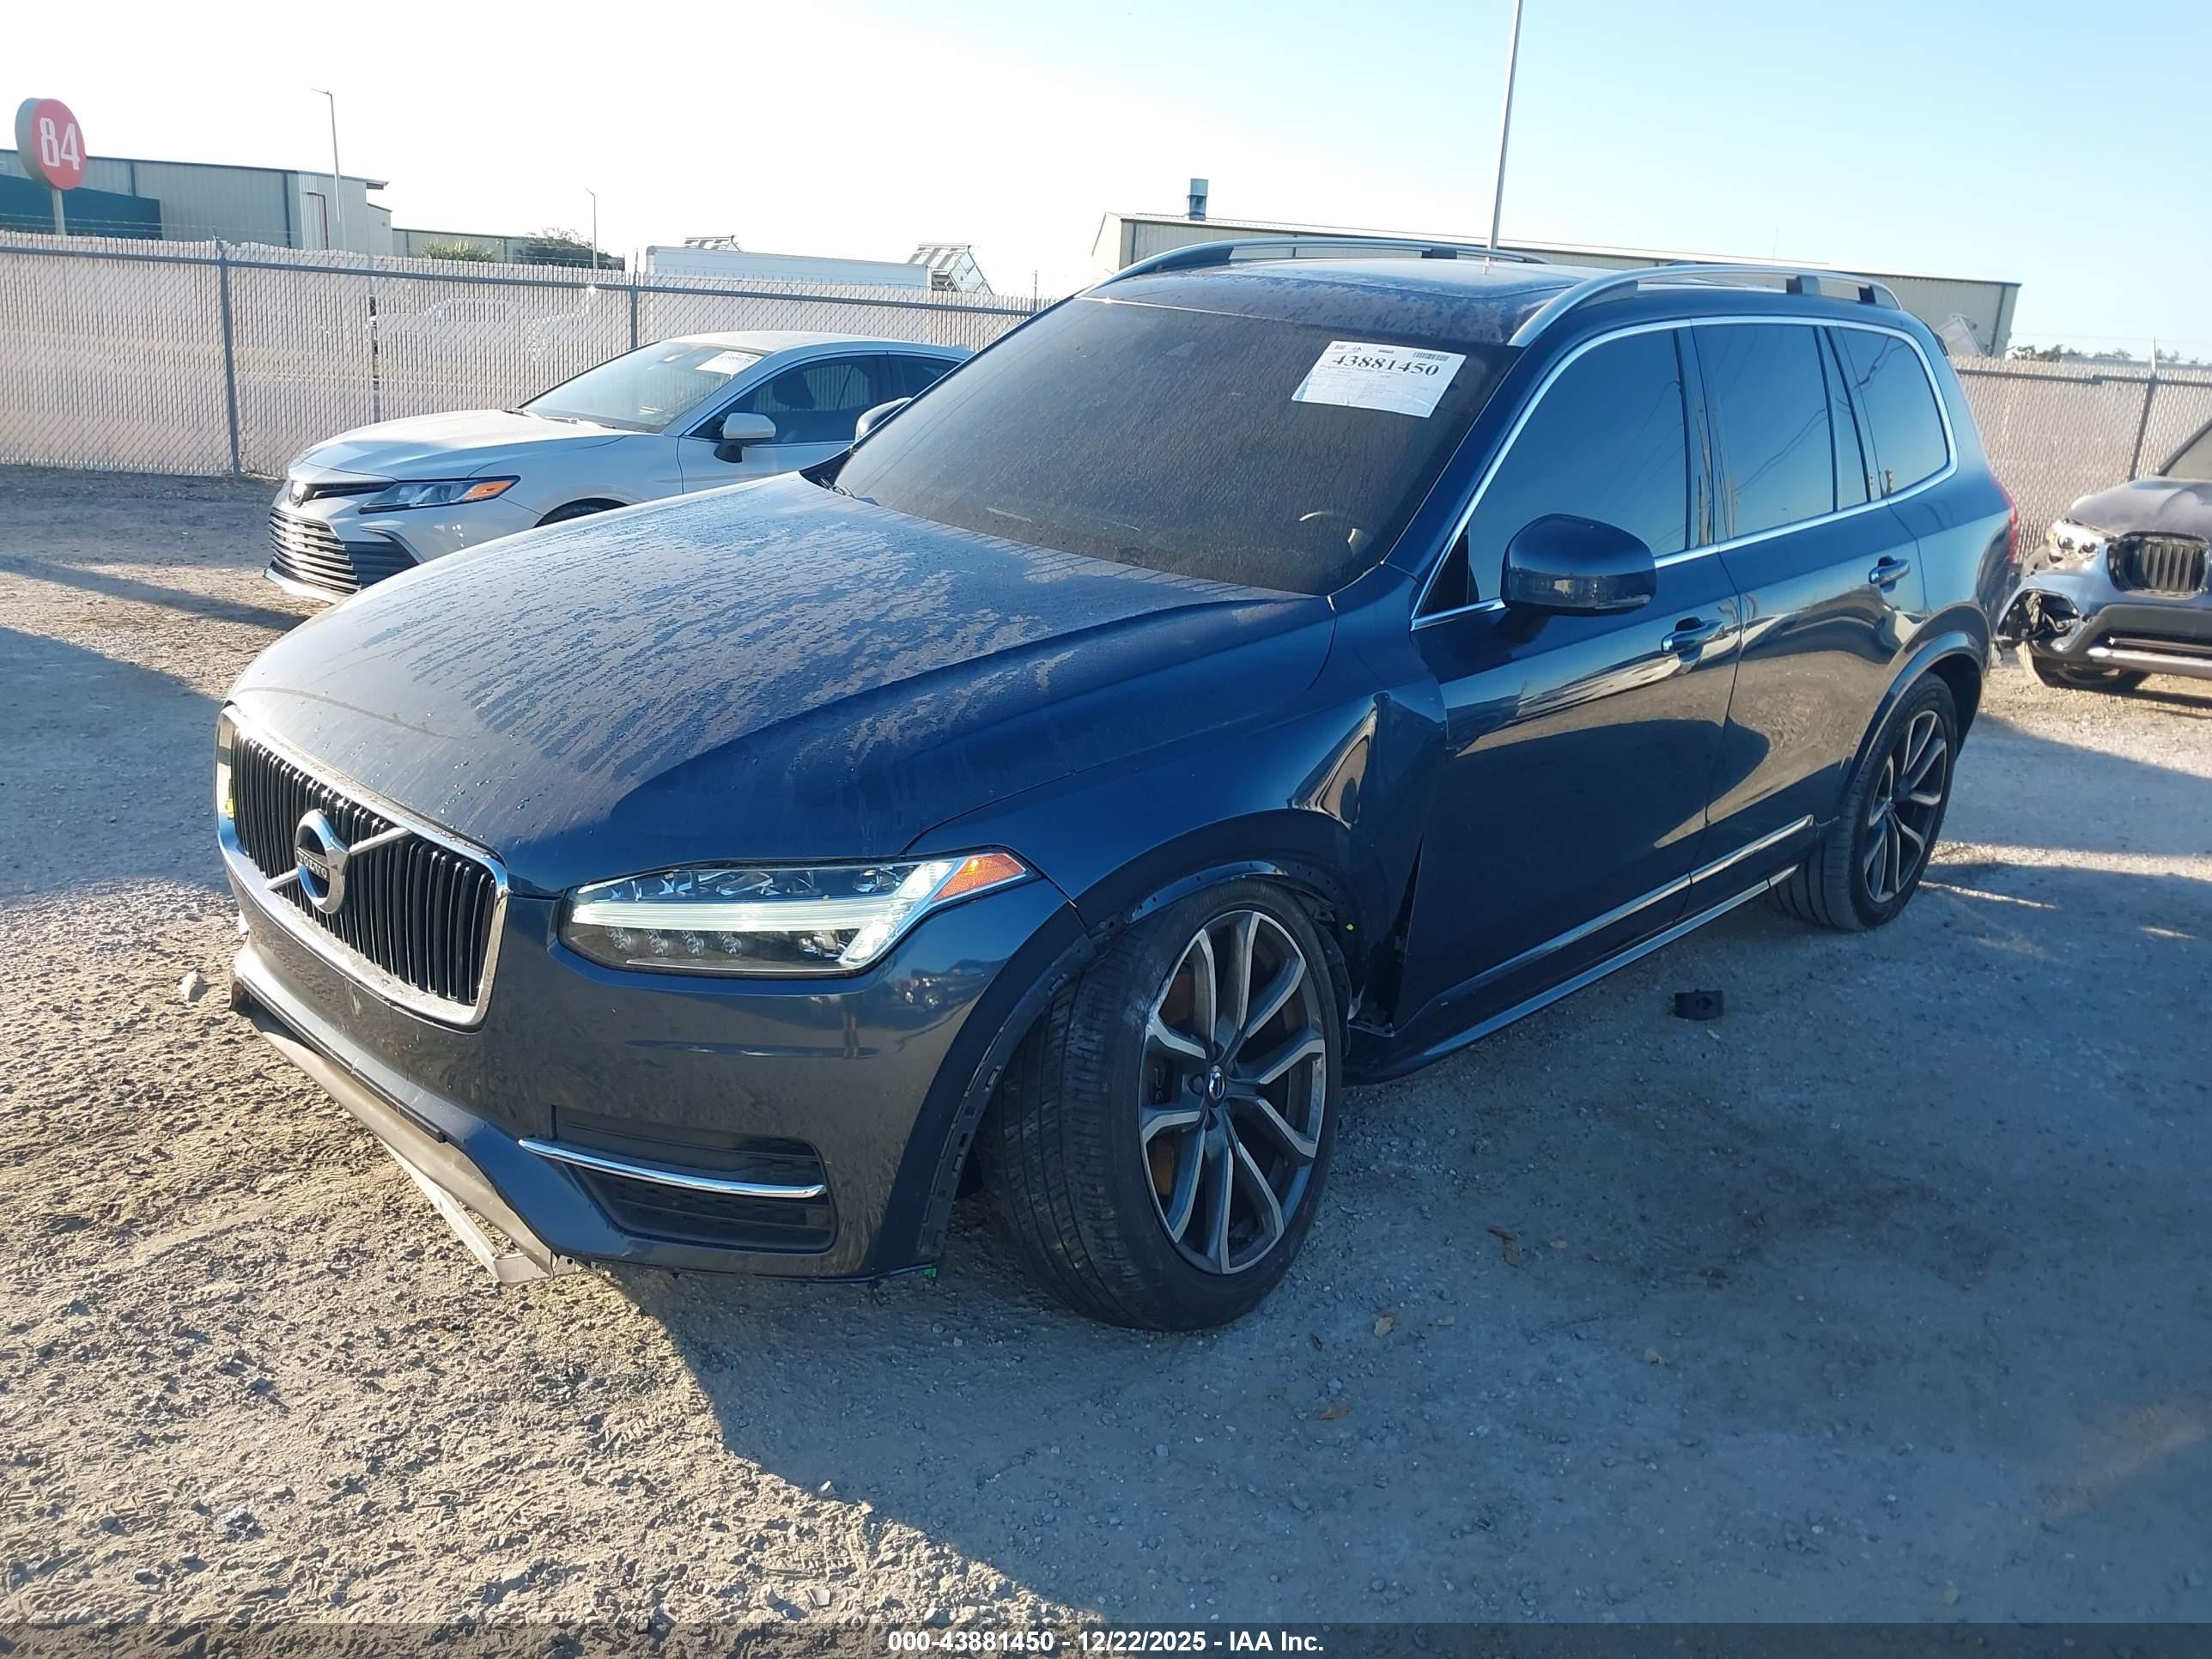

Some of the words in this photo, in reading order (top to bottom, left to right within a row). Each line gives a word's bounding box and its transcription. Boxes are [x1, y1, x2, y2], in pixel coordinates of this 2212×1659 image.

[40, 118, 80, 171] 84
[1332, 354, 1440, 376] 43881450
[298, 854, 328, 879] VOLVO
